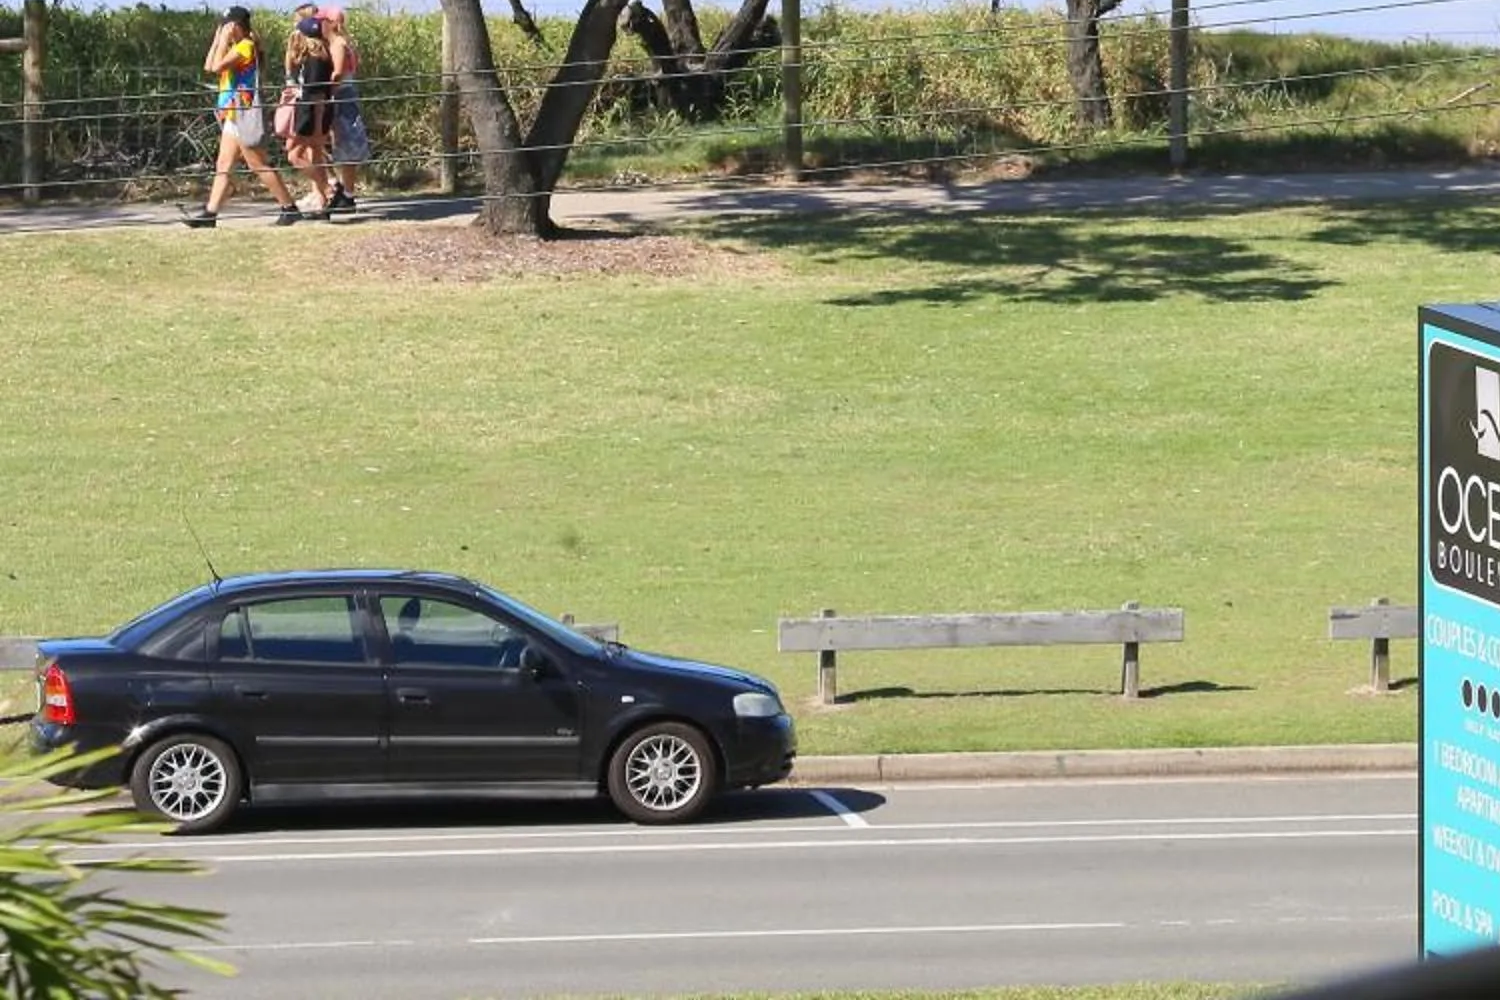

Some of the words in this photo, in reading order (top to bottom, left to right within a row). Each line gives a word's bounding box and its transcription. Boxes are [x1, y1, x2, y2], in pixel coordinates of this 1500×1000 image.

[1428, 615, 1476, 657] COUPLES
[1478, 633, 1487, 662] &
[1441, 743, 1498, 790] BEDROOM
[1433, 824, 1474, 863] WEEKLY
[1475, 840, 1485, 867] &
[1432, 889, 1462, 927] POOL
[1474, 907, 1493, 940] SPA
